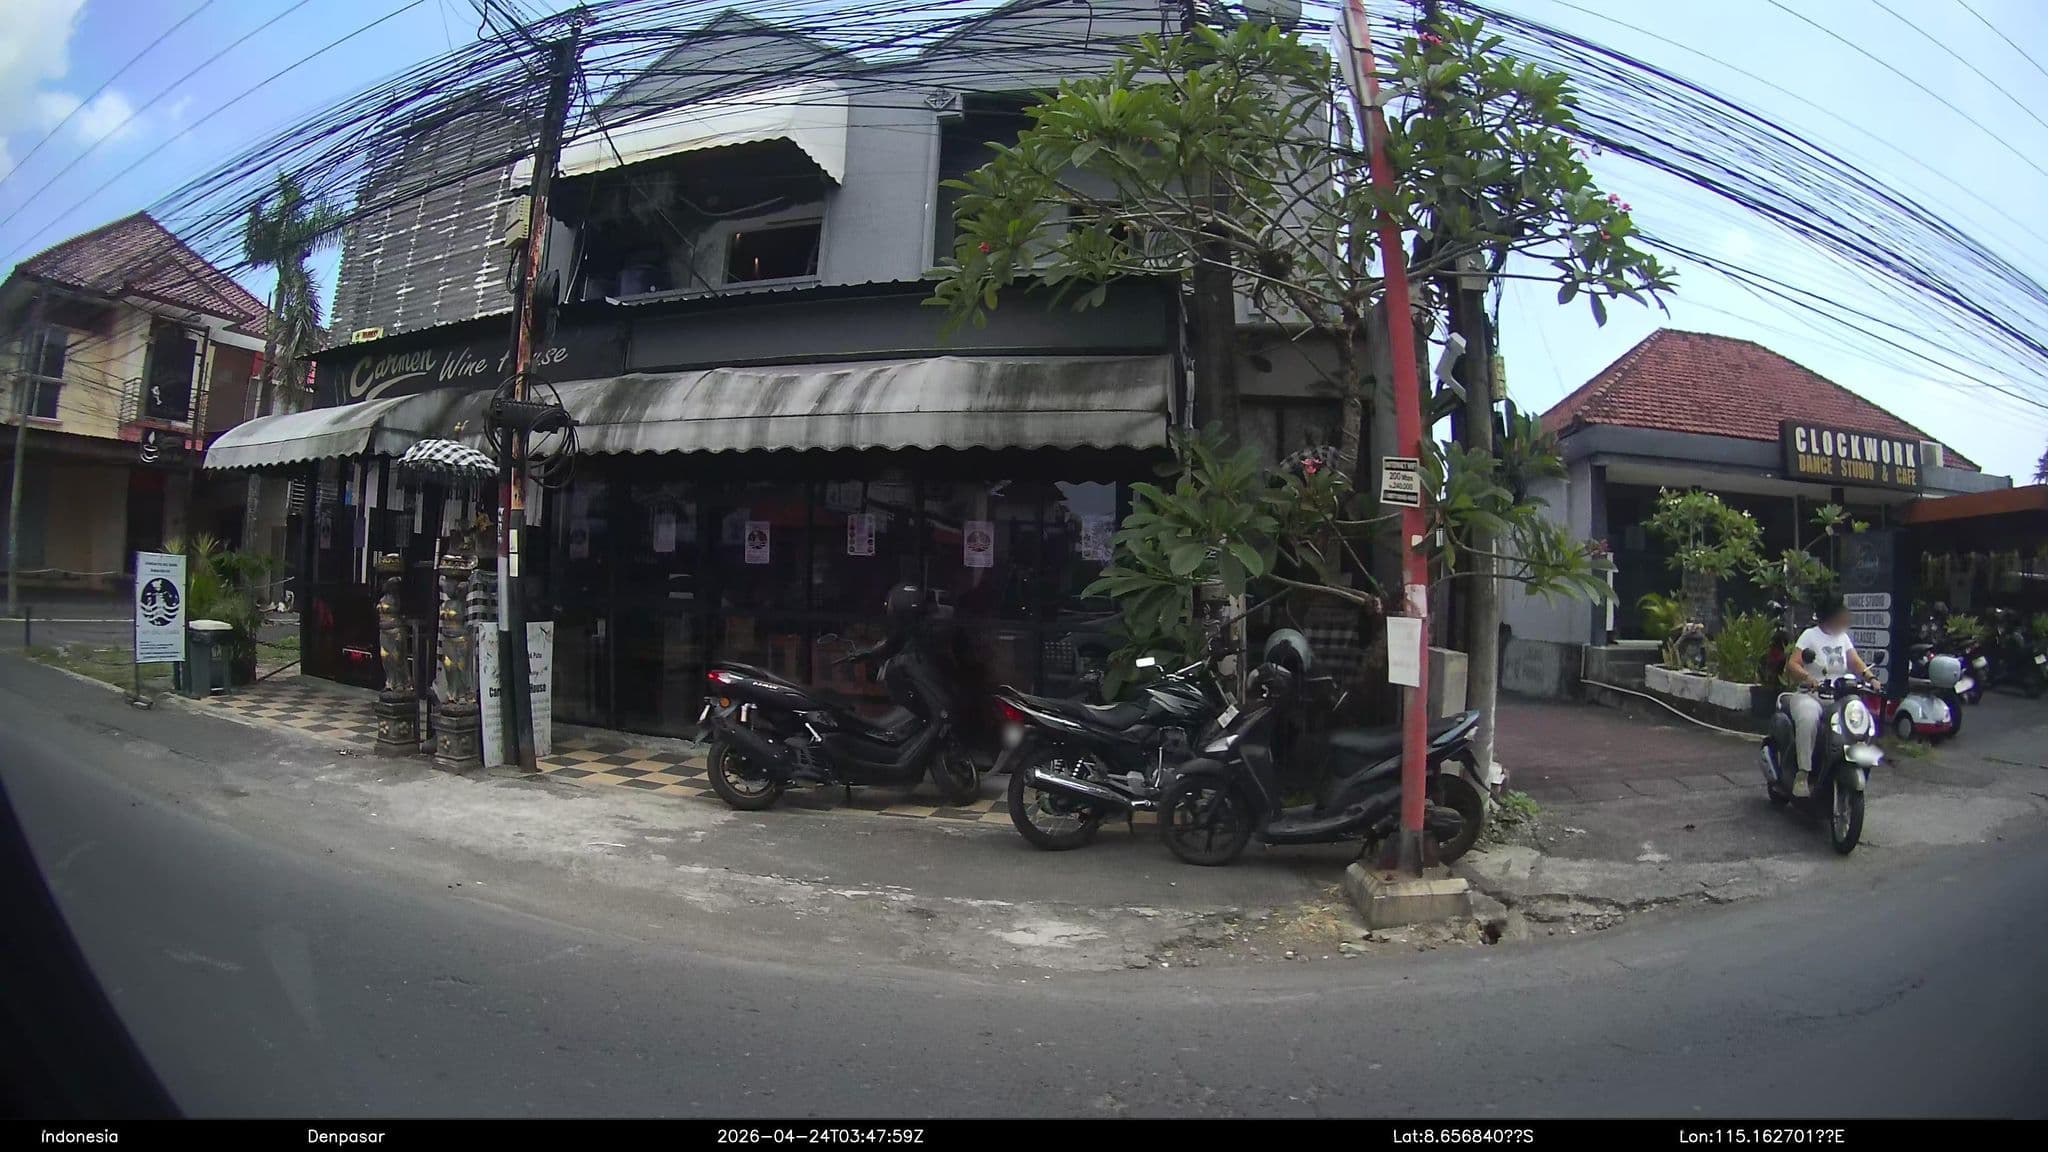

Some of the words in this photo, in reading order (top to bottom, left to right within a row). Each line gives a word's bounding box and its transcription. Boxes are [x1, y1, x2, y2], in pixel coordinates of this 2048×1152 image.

[350, 349, 436, 398] Carmen
[438, 347, 487, 382] Wine
[1795, 426, 1916, 468] CLOCKWORK
[1798, 454, 1833, 475] DANCE
[1840, 459, 1875, 480] STUDIO
[1881, 464, 1889, 482] &
[1895, 467, 1917, 486] CAFE
